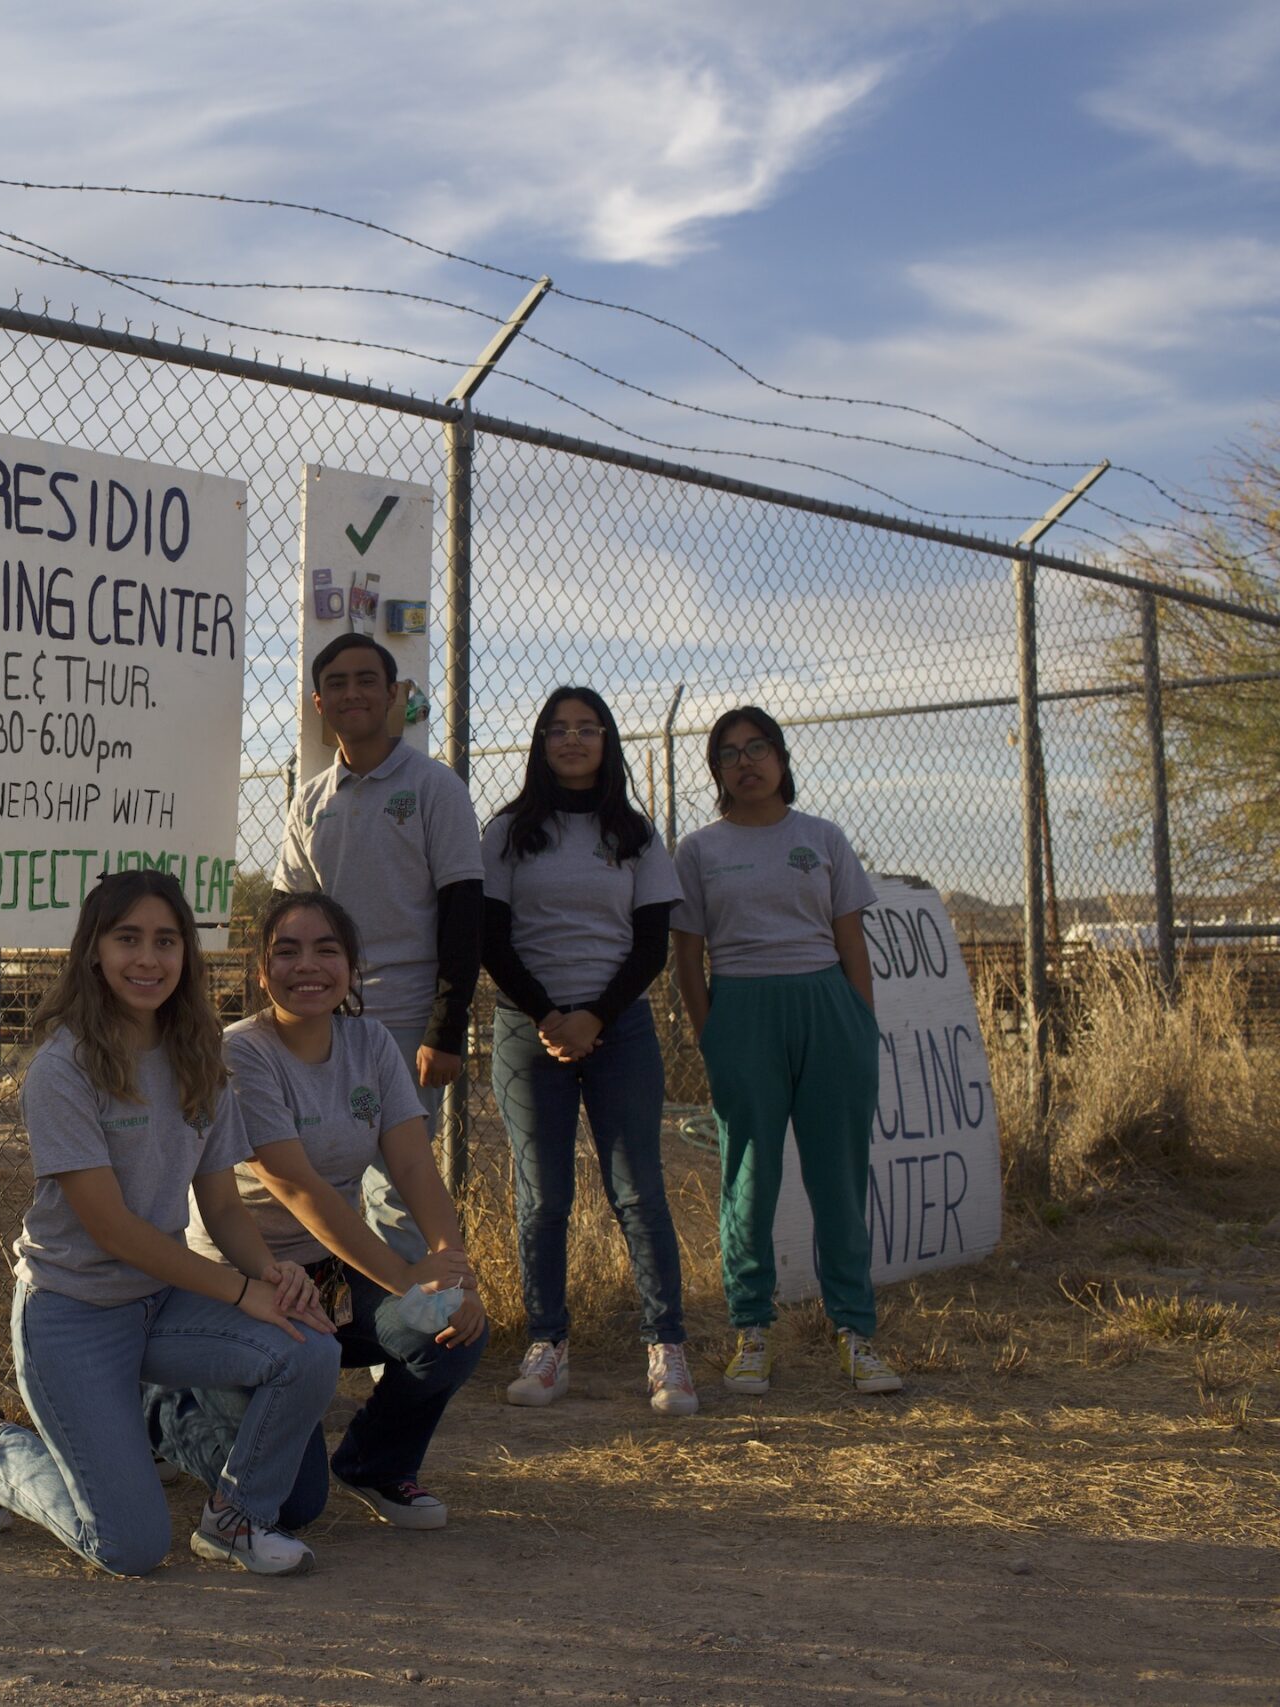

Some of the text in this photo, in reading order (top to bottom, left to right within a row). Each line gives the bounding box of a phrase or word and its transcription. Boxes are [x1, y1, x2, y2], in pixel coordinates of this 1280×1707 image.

[87, 575, 235, 660] CENTER
[33, 650, 46, 705] &
[55, 655, 157, 709] THUR.
[113, 787, 174, 830] WITH
[860, 907, 948, 981] SIDIO
[871, 1023, 985, 1144] CLING
